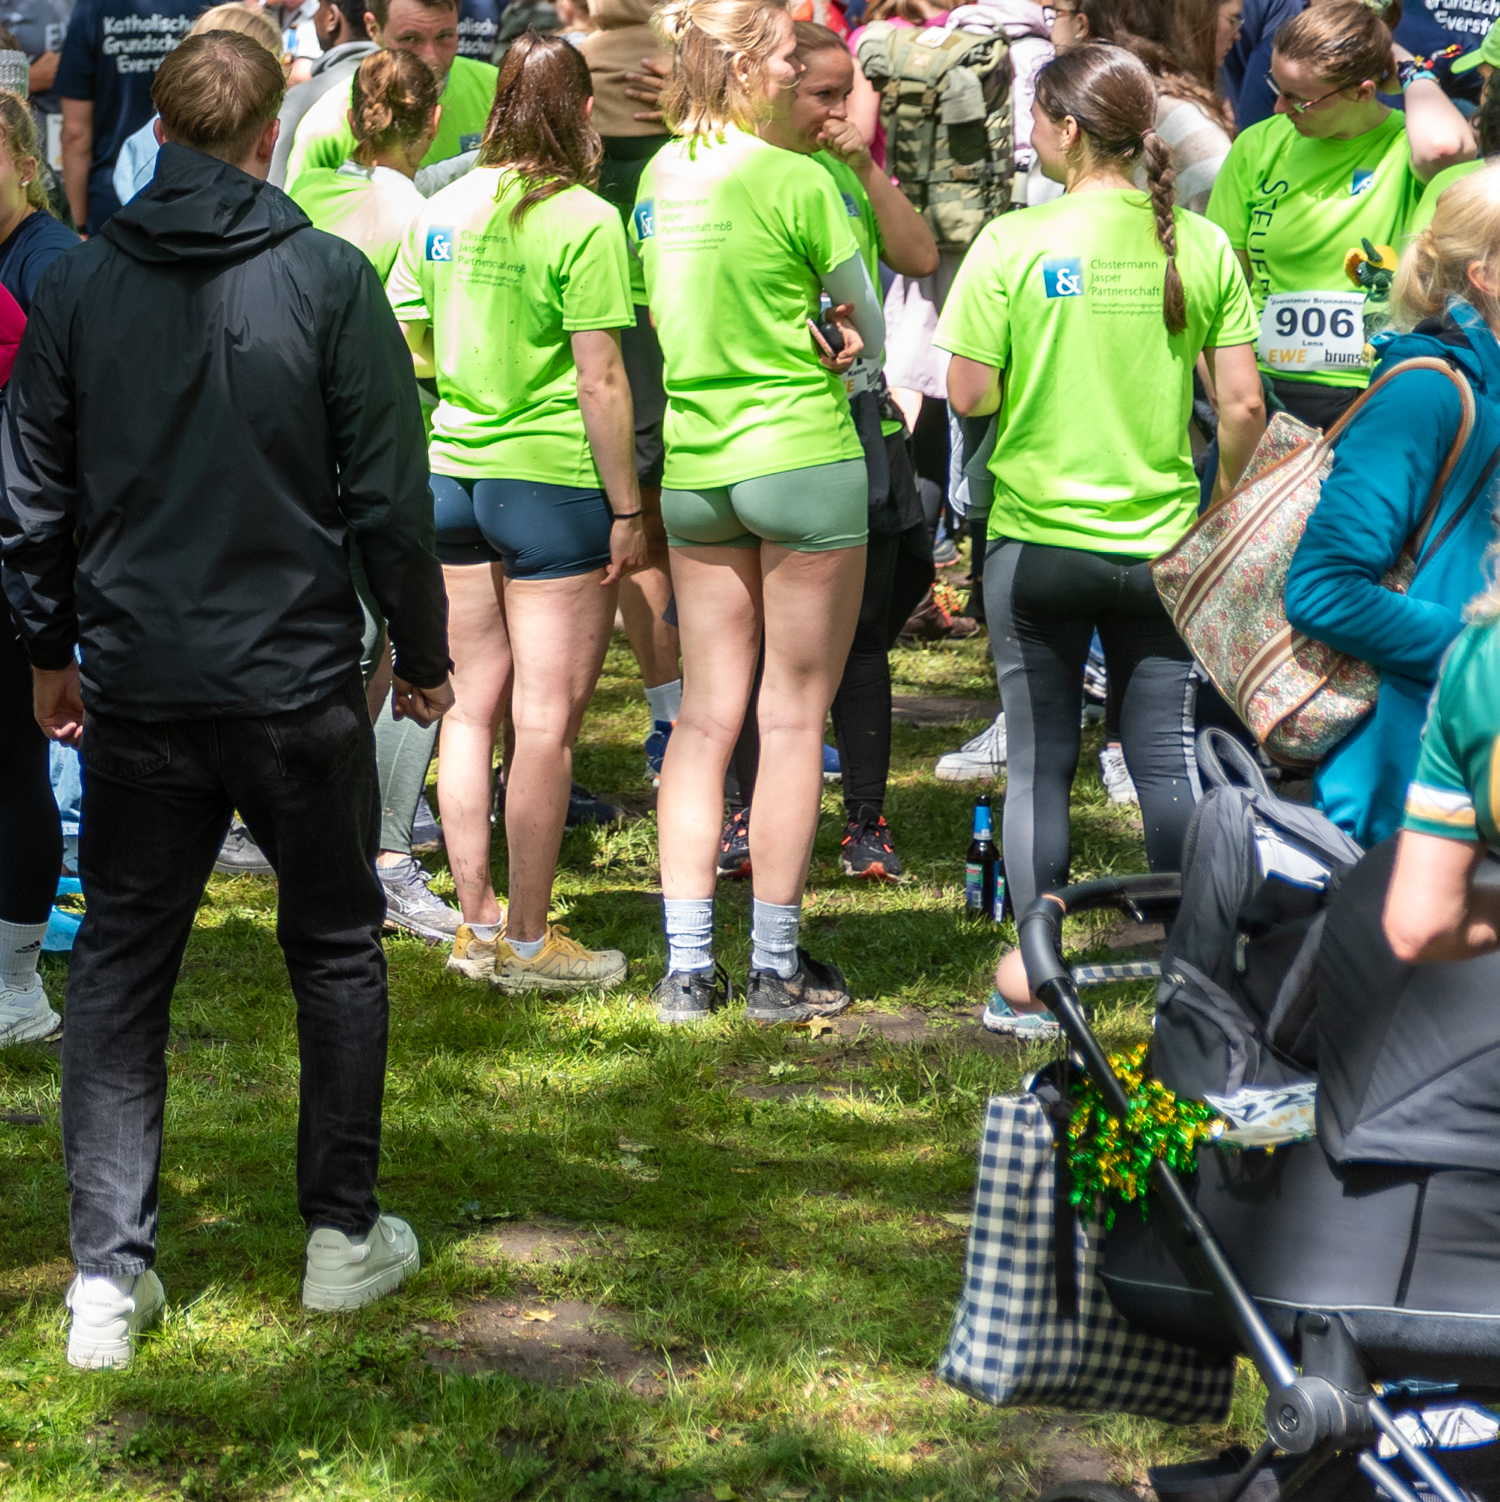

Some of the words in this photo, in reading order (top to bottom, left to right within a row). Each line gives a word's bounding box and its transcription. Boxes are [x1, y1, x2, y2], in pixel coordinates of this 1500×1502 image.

[1434, 10, 1494, 35] Everst
[1090, 259, 1158, 269] Clostermann
[1090, 273, 1122, 284] Jasper
[1091, 286, 1160, 296] Partnerschaft
[1276, 307, 1354, 338] 906
[1268, 349, 1307, 364] EWE
